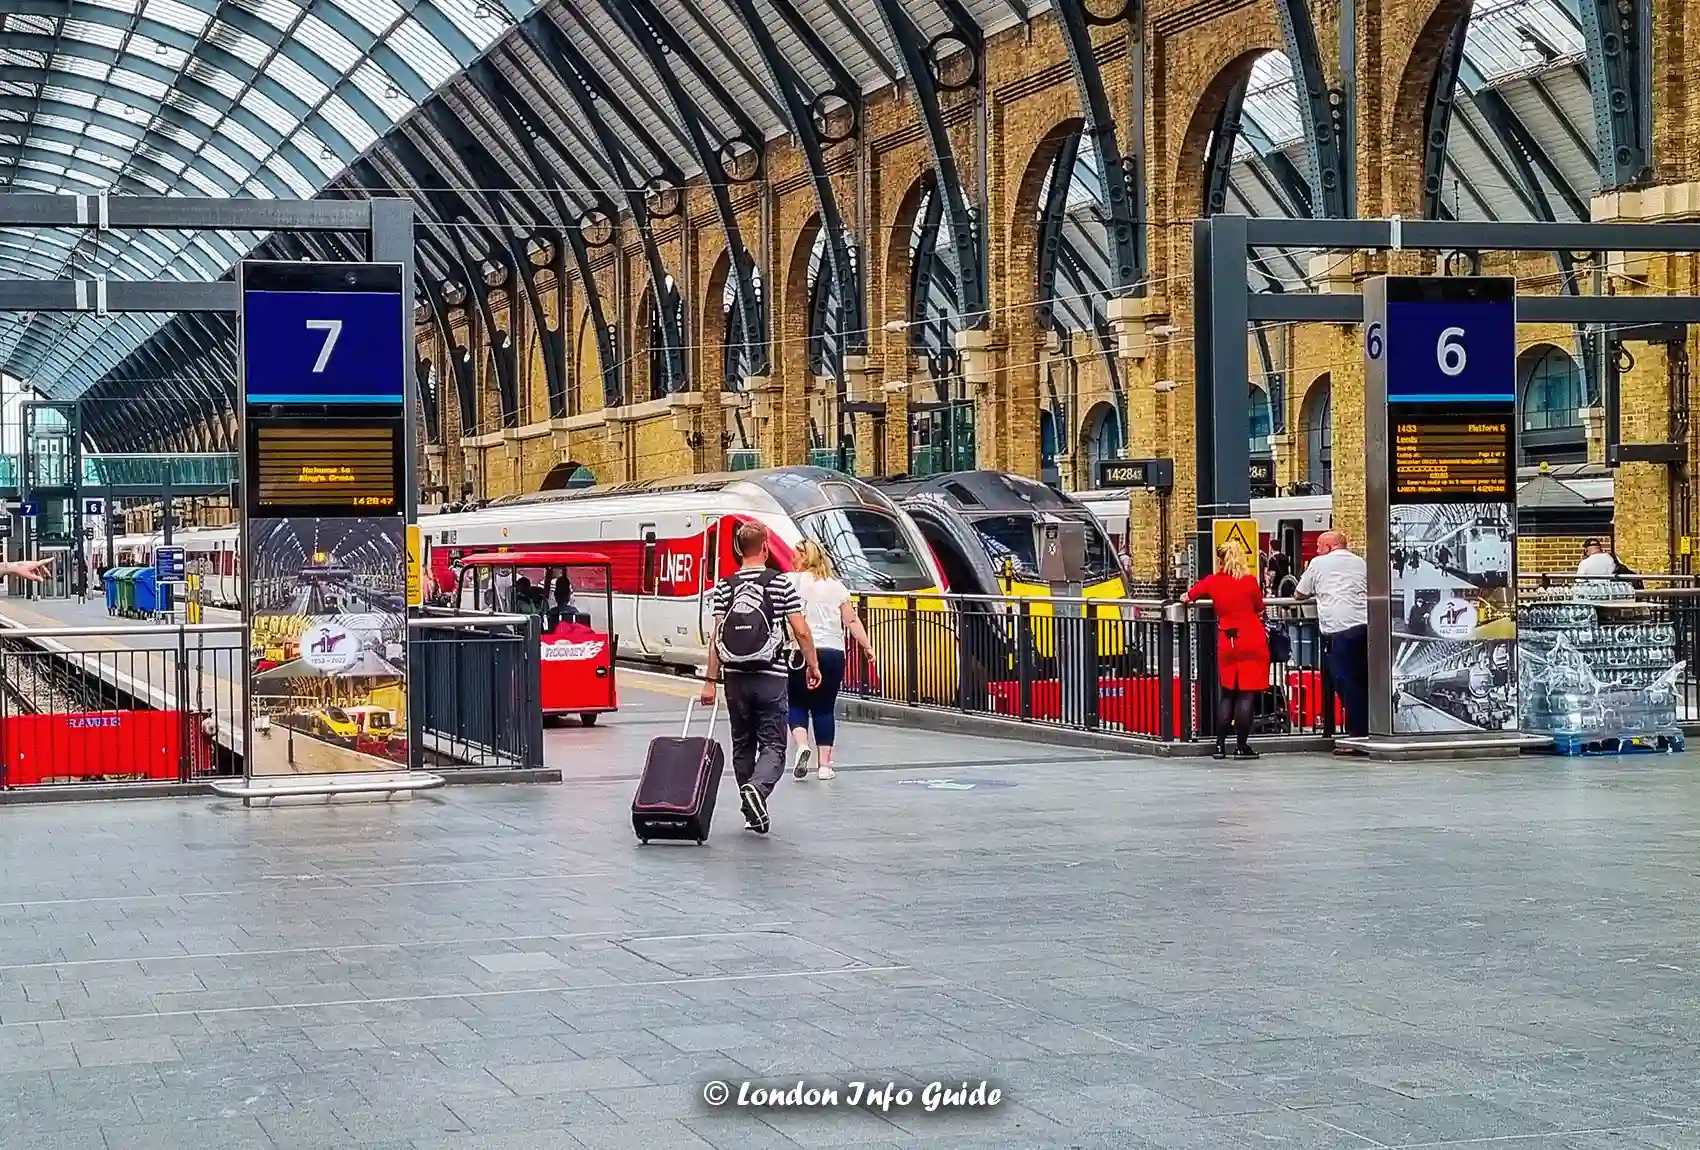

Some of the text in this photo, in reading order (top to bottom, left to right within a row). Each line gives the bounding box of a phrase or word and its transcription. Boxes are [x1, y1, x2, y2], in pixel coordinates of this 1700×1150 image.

[306, 319, 343, 373] 7
[1366, 321, 1384, 360] 6
[1436, 326, 1467, 377] 6
[24, 504, 32, 513] 7
[90, 503, 98, 513] 6
[660, 547, 694, 588] LNER
